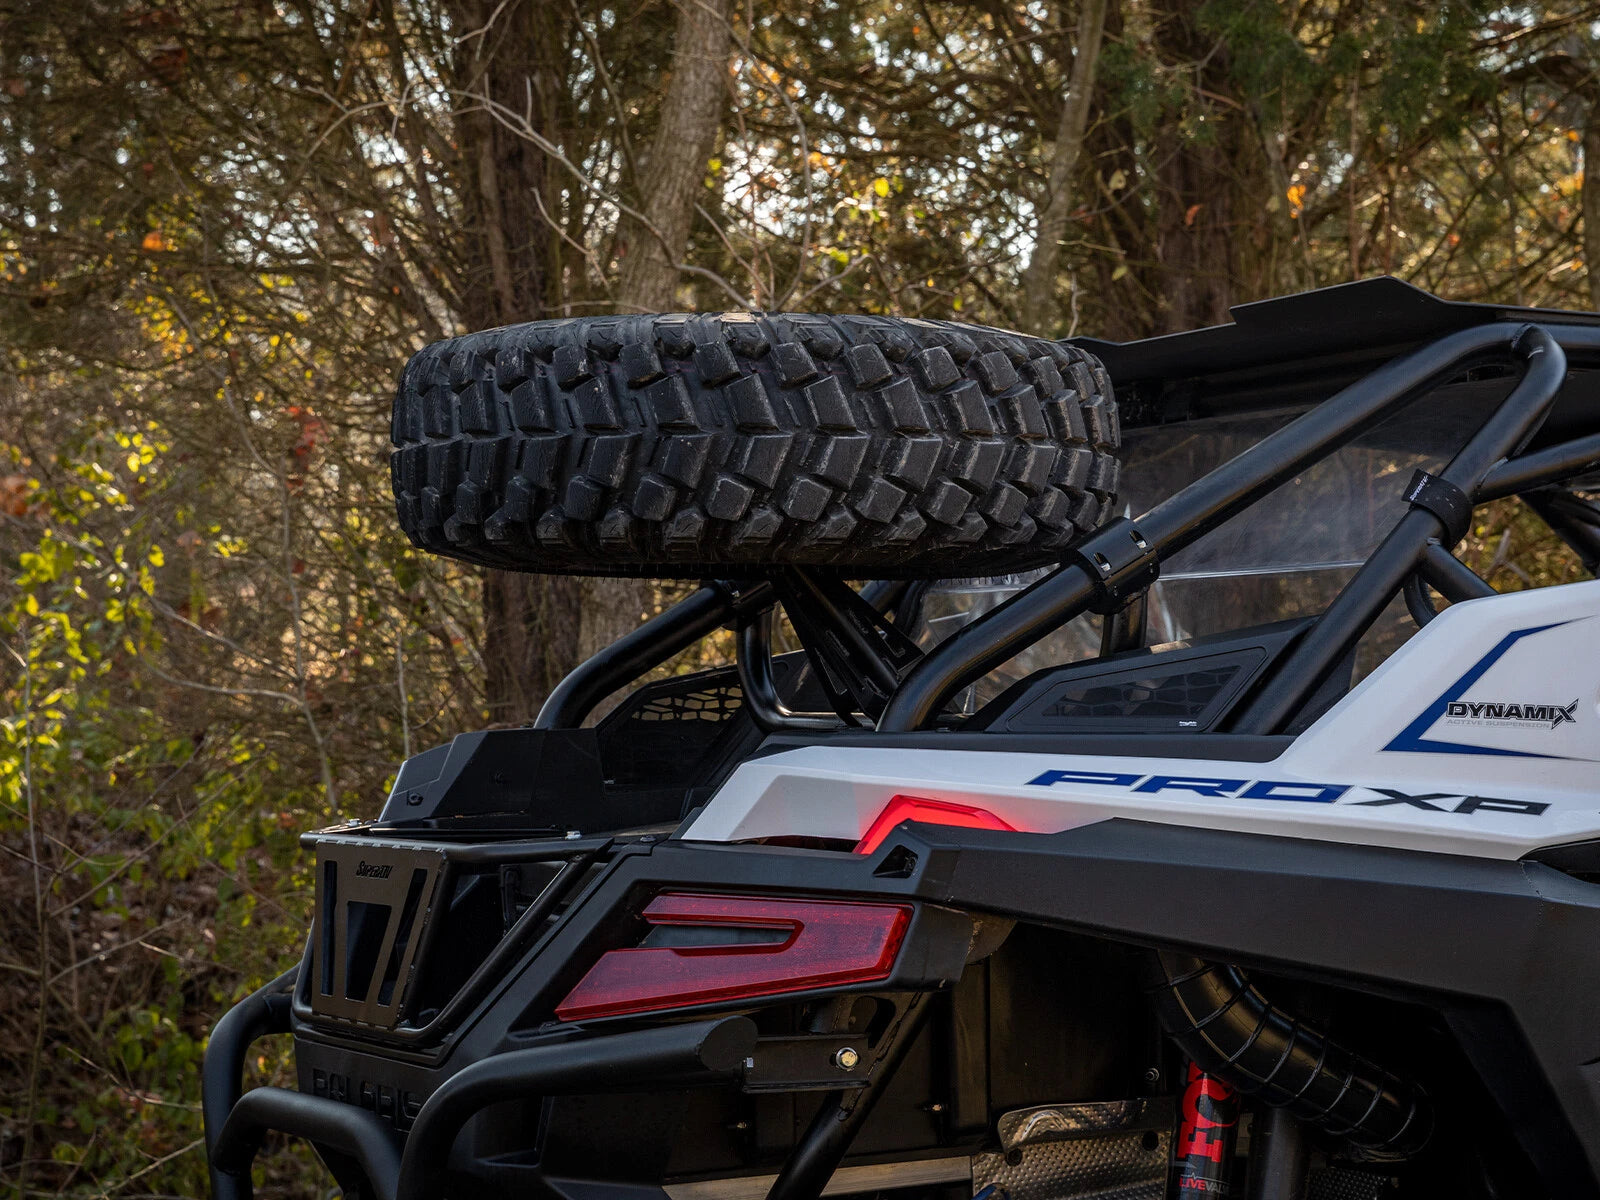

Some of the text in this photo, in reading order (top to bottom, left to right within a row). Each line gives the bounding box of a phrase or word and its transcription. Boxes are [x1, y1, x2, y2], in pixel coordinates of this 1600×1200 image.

[1446, 698, 1579, 730] DYNAMIX
[1486, 721, 1551, 729] SUSPENSION
[1024, 769, 1553, 816] PRO XP
[1177, 1061, 1240, 1163] FO
